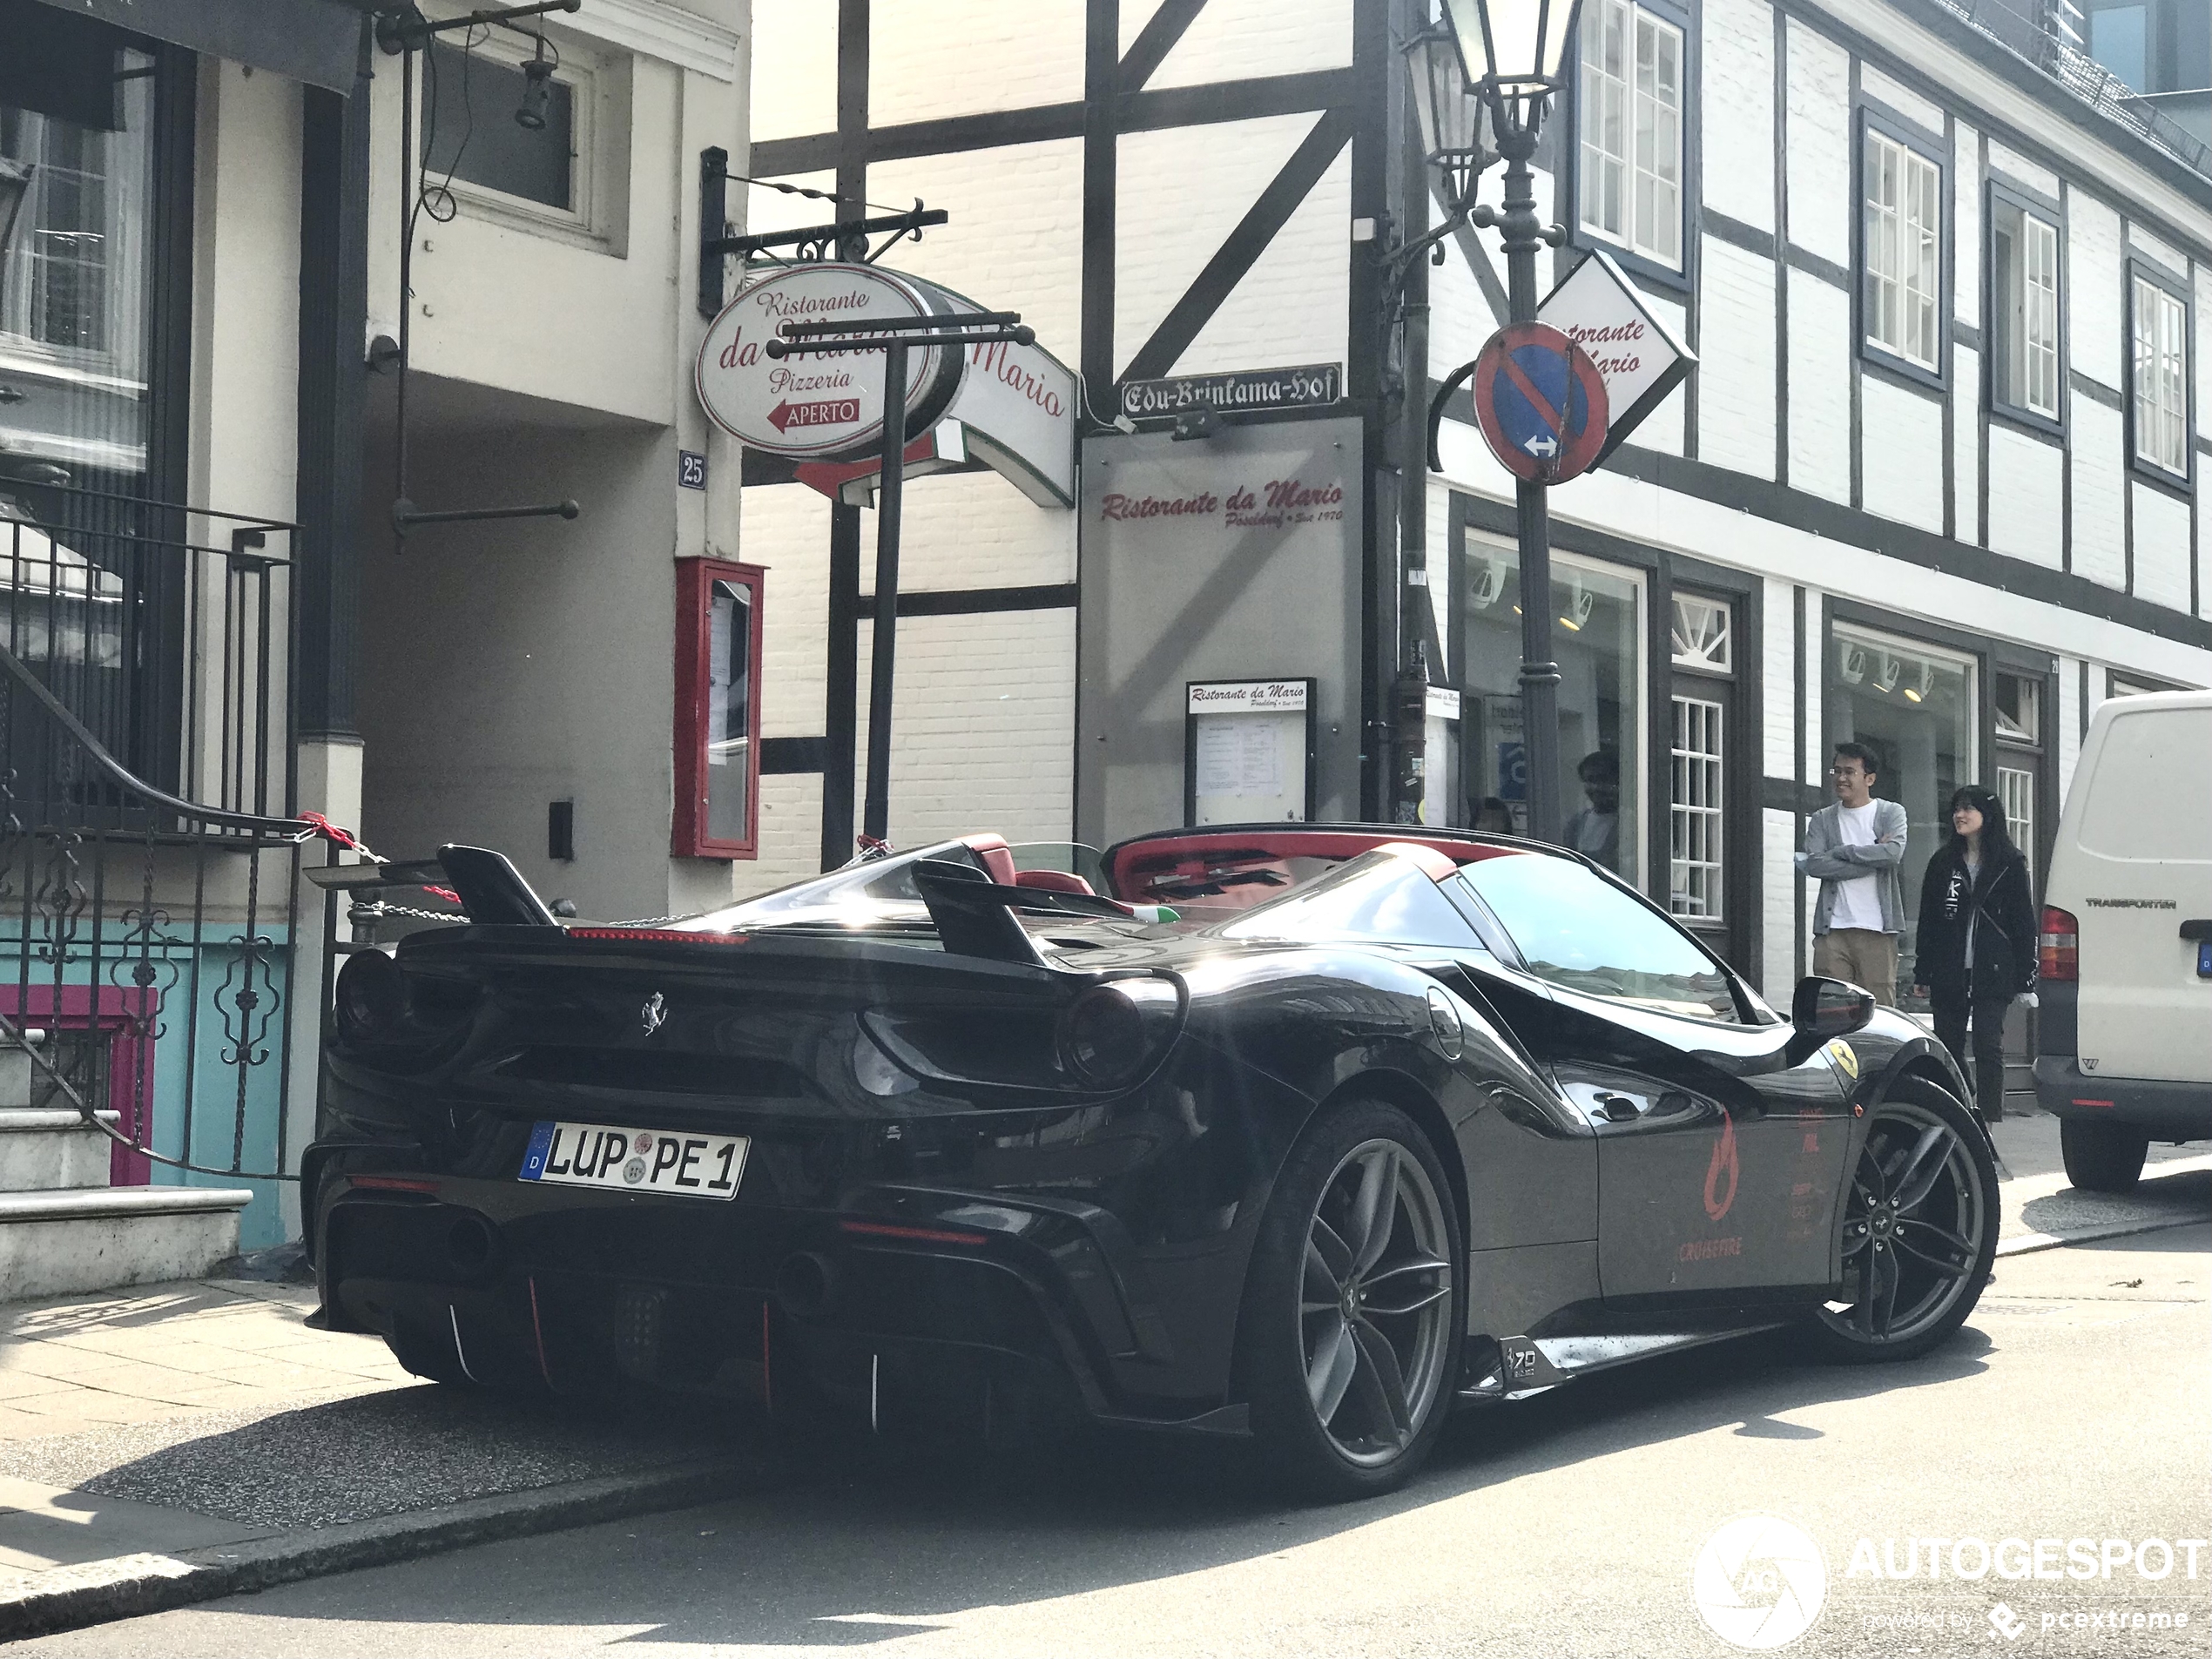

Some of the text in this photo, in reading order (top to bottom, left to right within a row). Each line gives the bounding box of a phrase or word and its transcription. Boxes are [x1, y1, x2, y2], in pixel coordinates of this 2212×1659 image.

[756, 290, 870, 318] Ristorante
[1562, 319, 1645, 344] torante
[718, 326, 766, 369] da
[1587, 350, 1641, 375] ario
[769, 369, 853, 395] Pizzeria
[786, 401, 856, 427] APERTO
[682, 458, 704, 484] 25
[1101, 479, 1343, 522] Ristorante da Mario
[1318, 510, 1344, 522] 1970
[1191, 685, 1304, 702] Ristorante da Mario
[2085, 898, 2176, 909] TRANSPORTER
[529, 1129, 735, 1190] D LUP PE 1
